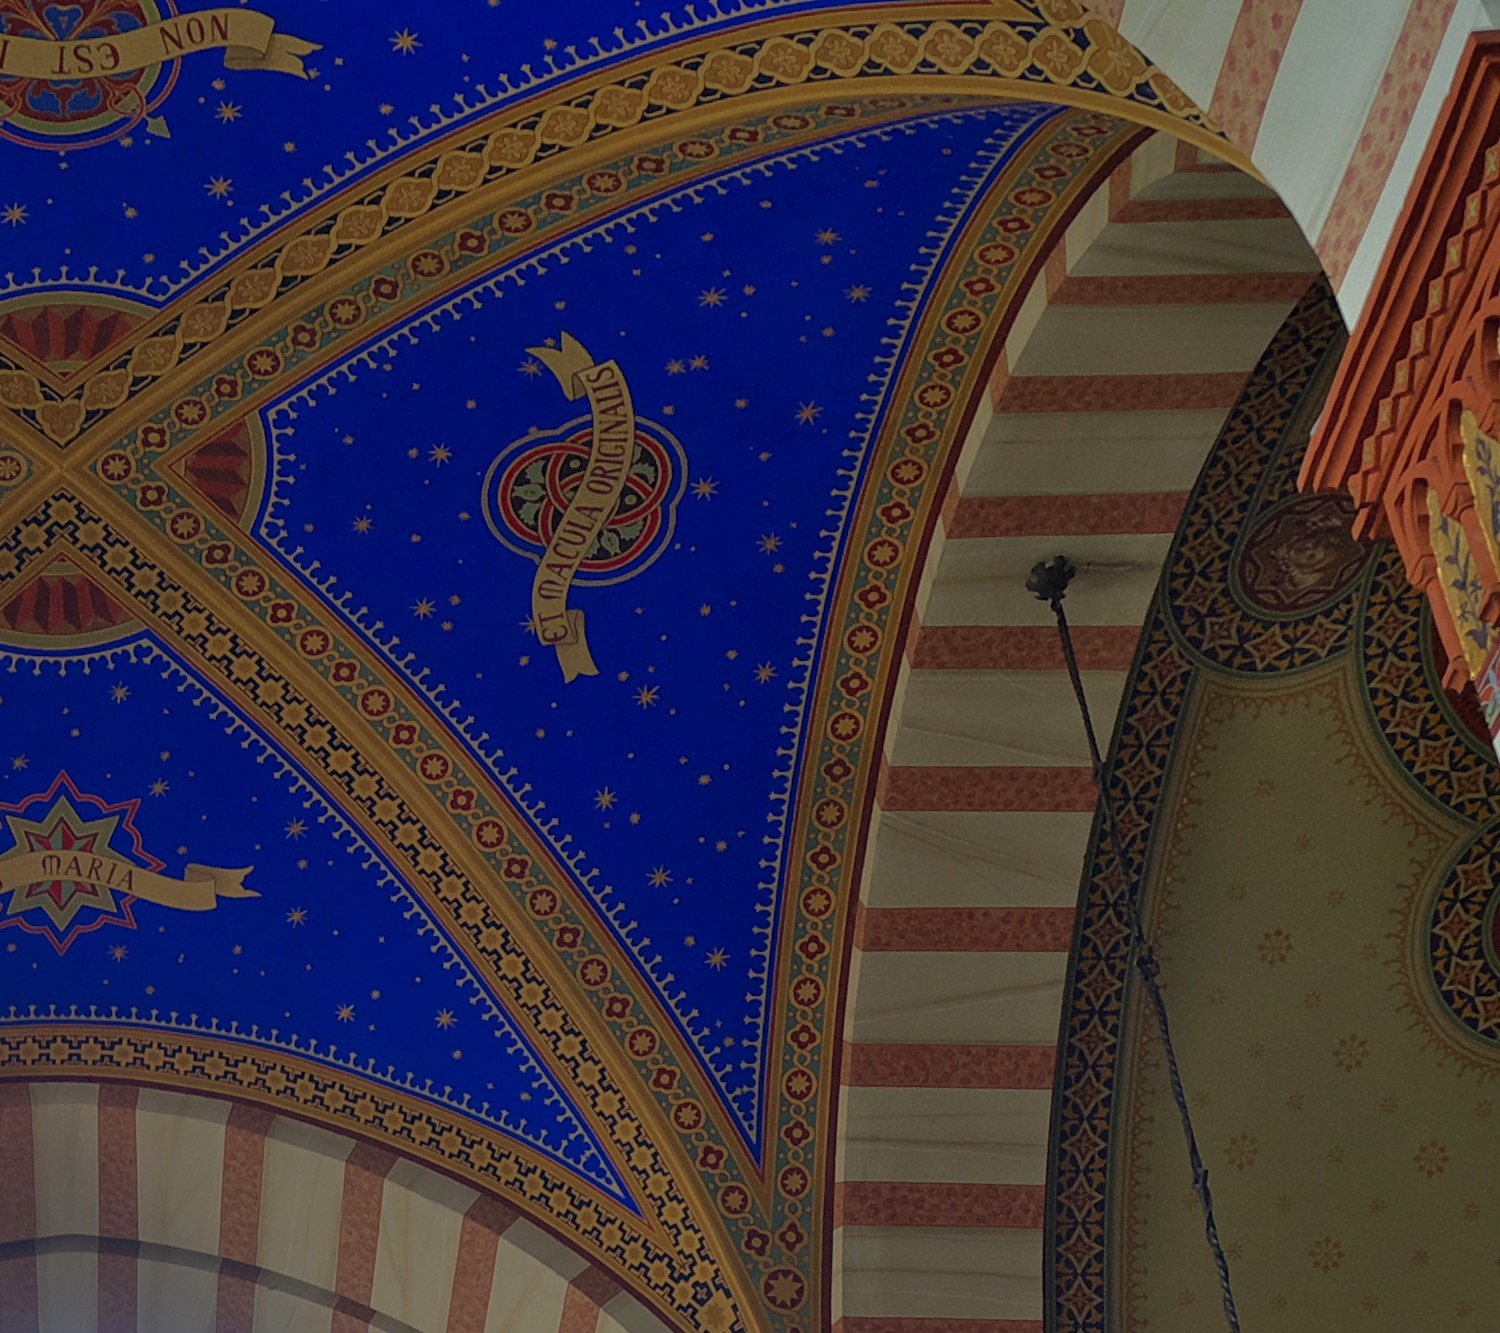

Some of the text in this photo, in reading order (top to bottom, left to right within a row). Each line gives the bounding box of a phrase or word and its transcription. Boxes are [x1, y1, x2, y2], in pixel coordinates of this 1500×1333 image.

[160, 13, 230, 55] NON
[50, 42, 121, 76] EST
[538, 366, 631, 644] ET MACULA ORIGINALIS
[41, 854, 136, 892] MARIA
